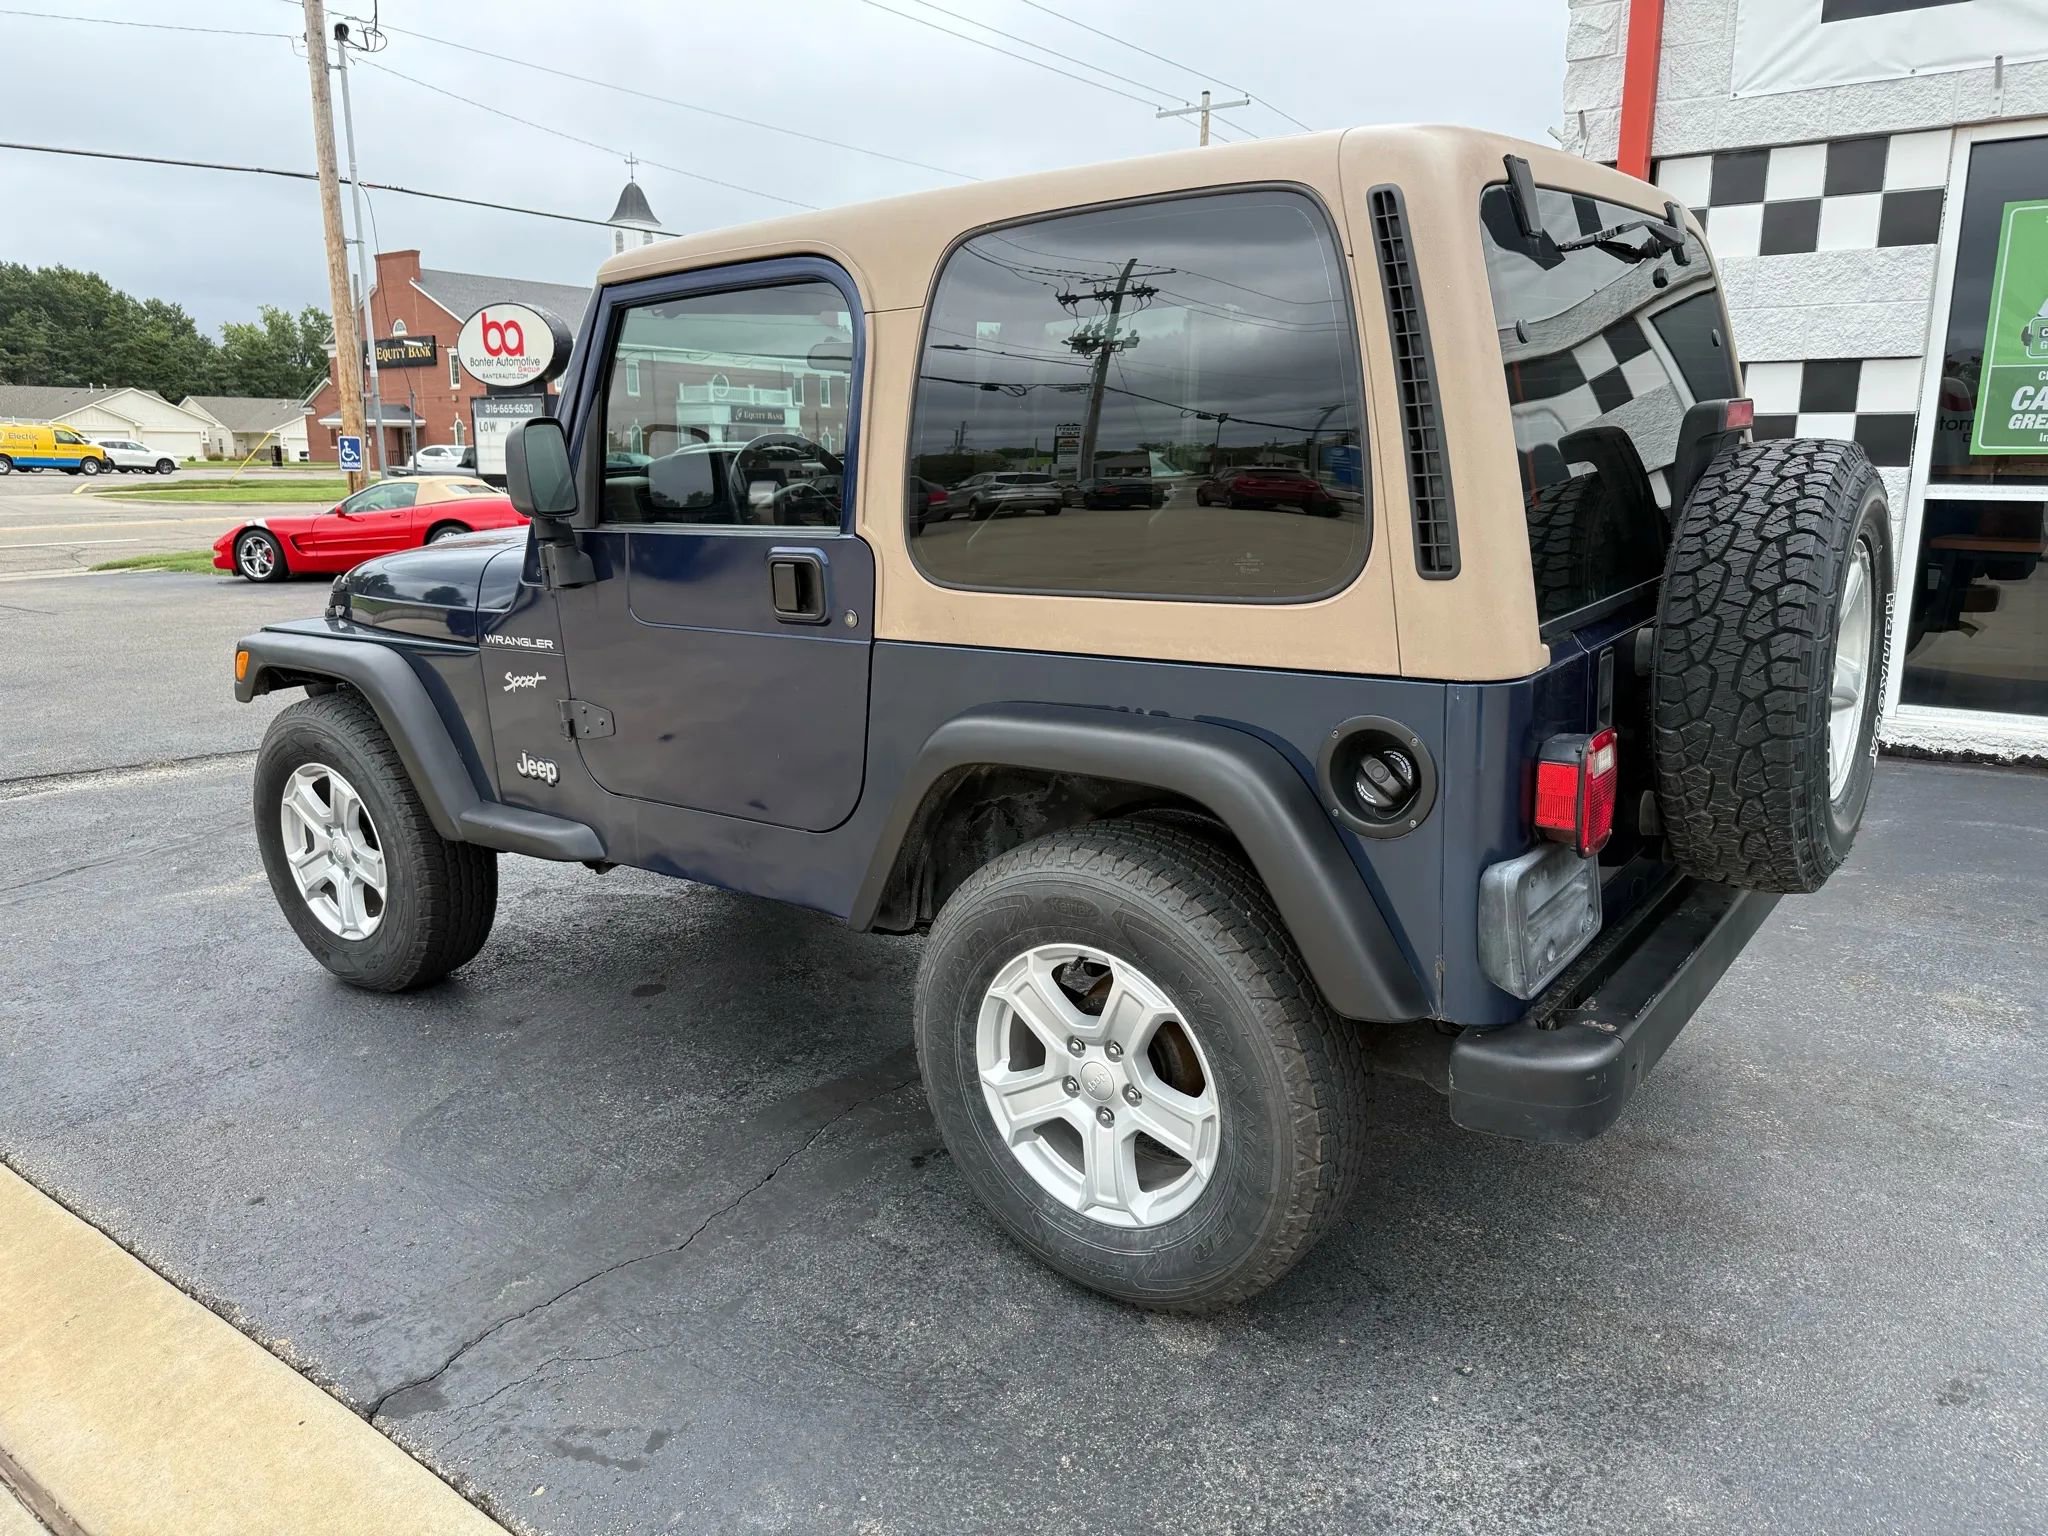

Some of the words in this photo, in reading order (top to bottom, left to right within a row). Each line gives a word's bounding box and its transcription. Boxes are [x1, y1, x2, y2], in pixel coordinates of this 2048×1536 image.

[376, 346, 406, 362] EQUITY
[408, 345, 432, 358] BANK
[470, 357, 494, 367] Banter
[496, 356, 541, 367] Automotive
[479, 421, 497, 433] LOW
[484, 633, 554, 650] WRANGLER
[503, 671, 547, 693] Sport
[516, 749, 560, 787] Jeep
